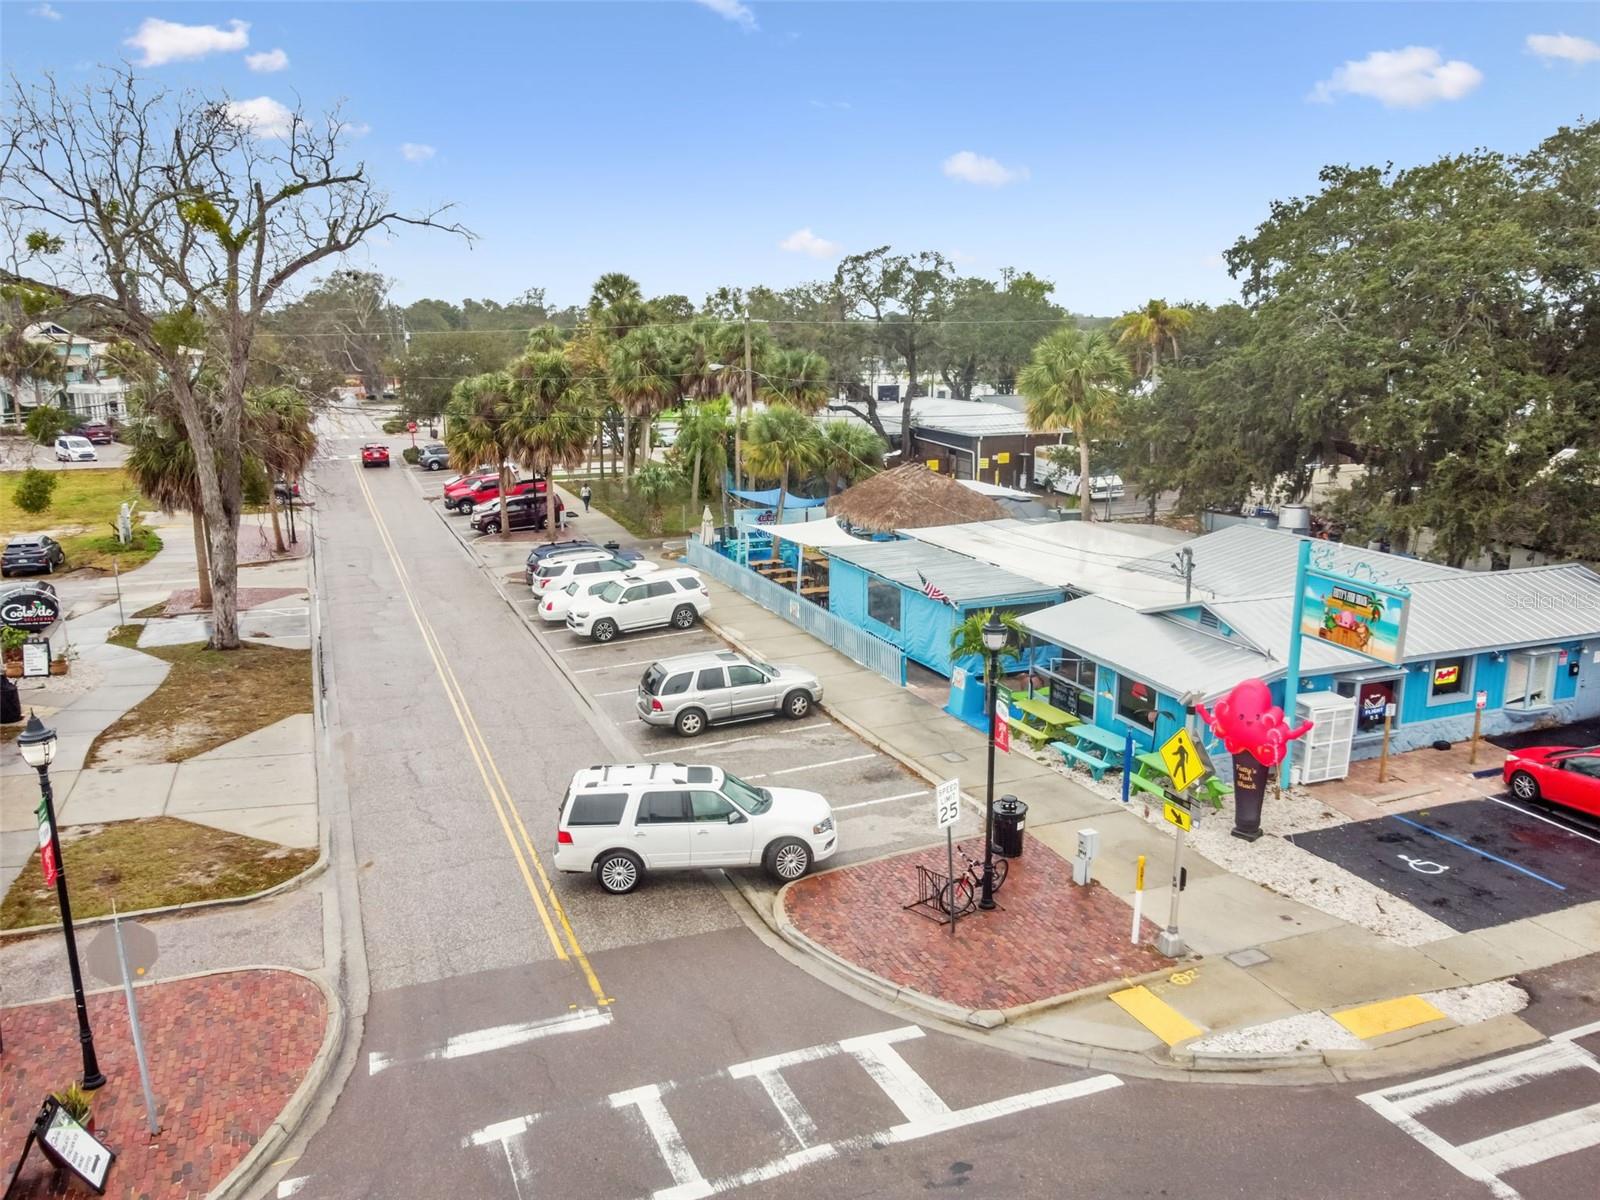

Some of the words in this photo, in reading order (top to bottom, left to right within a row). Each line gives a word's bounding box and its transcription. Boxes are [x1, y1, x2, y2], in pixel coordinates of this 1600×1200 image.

[938, 782, 958, 797] SPEED
[940, 792, 957, 805] LIMIT
[940, 801, 958, 824] 25
